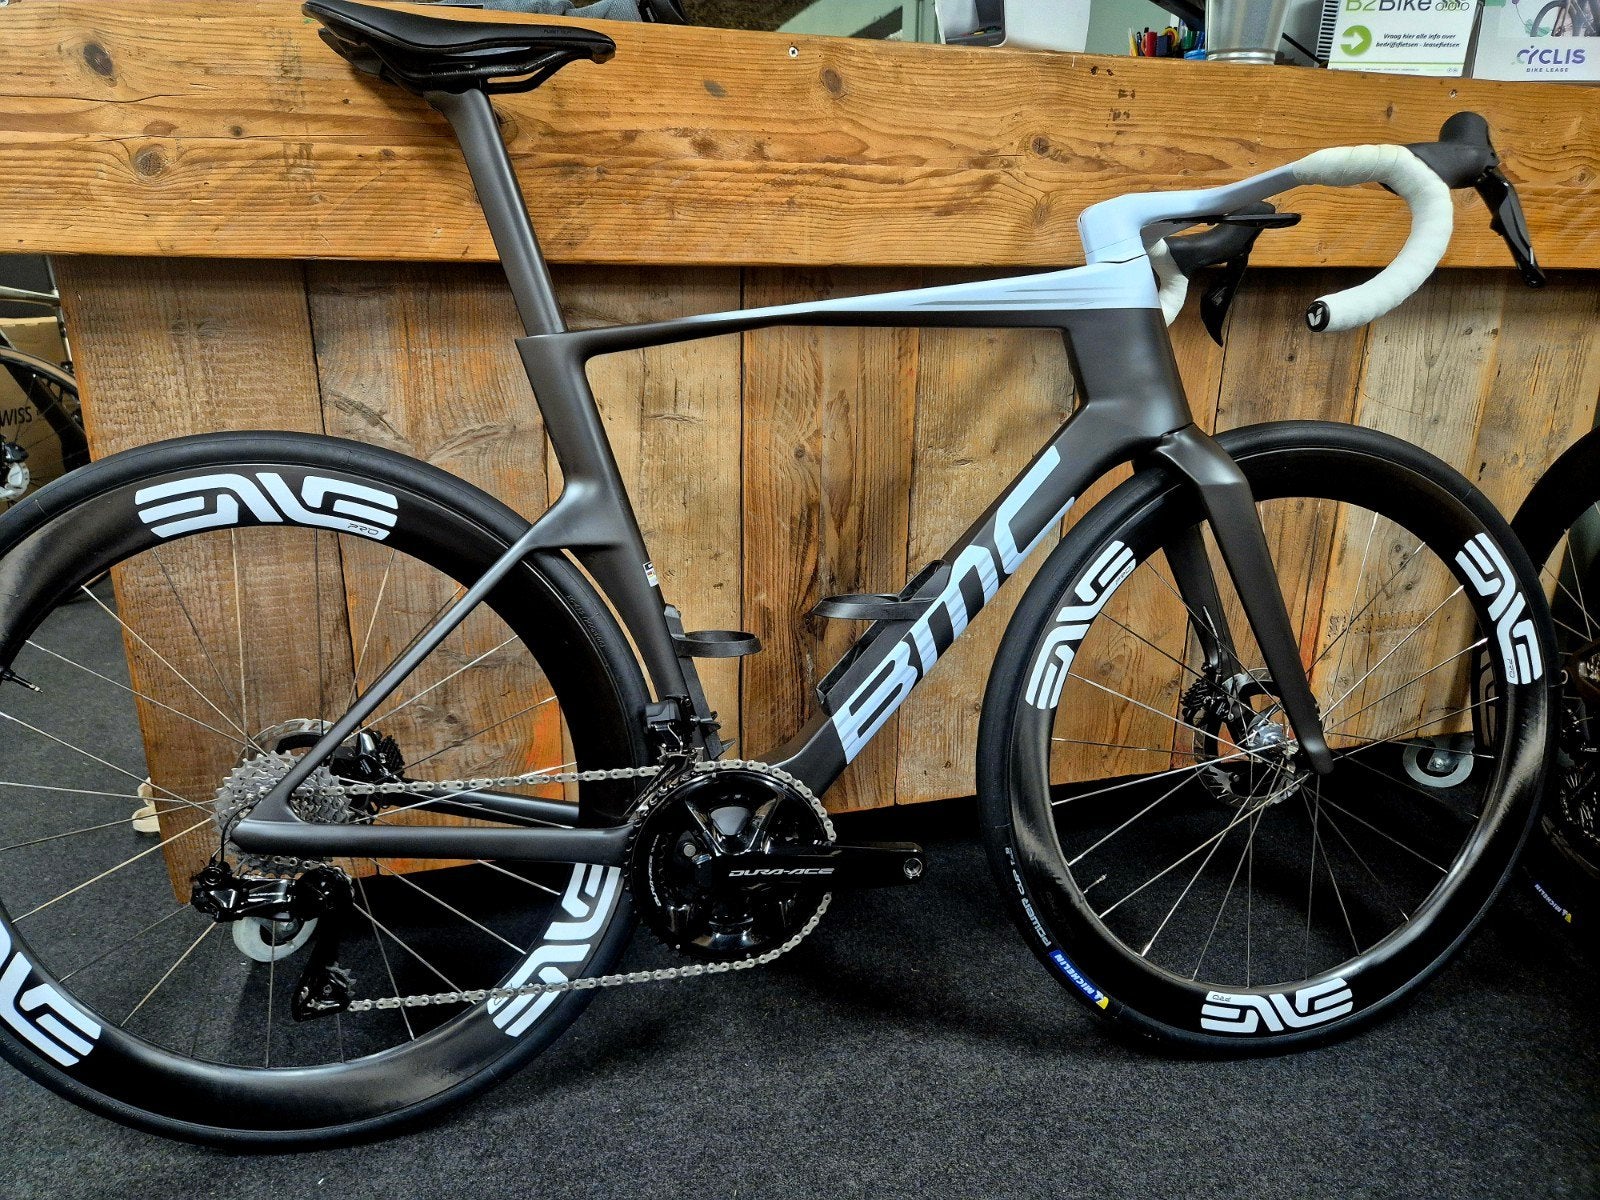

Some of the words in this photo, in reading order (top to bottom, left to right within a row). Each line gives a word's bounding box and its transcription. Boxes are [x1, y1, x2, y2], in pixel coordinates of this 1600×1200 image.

[1516, 46, 1586, 64] CYCLIS
[832, 445, 1075, 764] BMC
[728, 867, 835, 877] DURA-ACE
[1012, 869, 1025, 895] CUP
[1535, 883, 1562, 912] MICHELIN
[1021, 897, 1052, 947] POWER
[1054, 953, 1096, 995] MICHELIN
